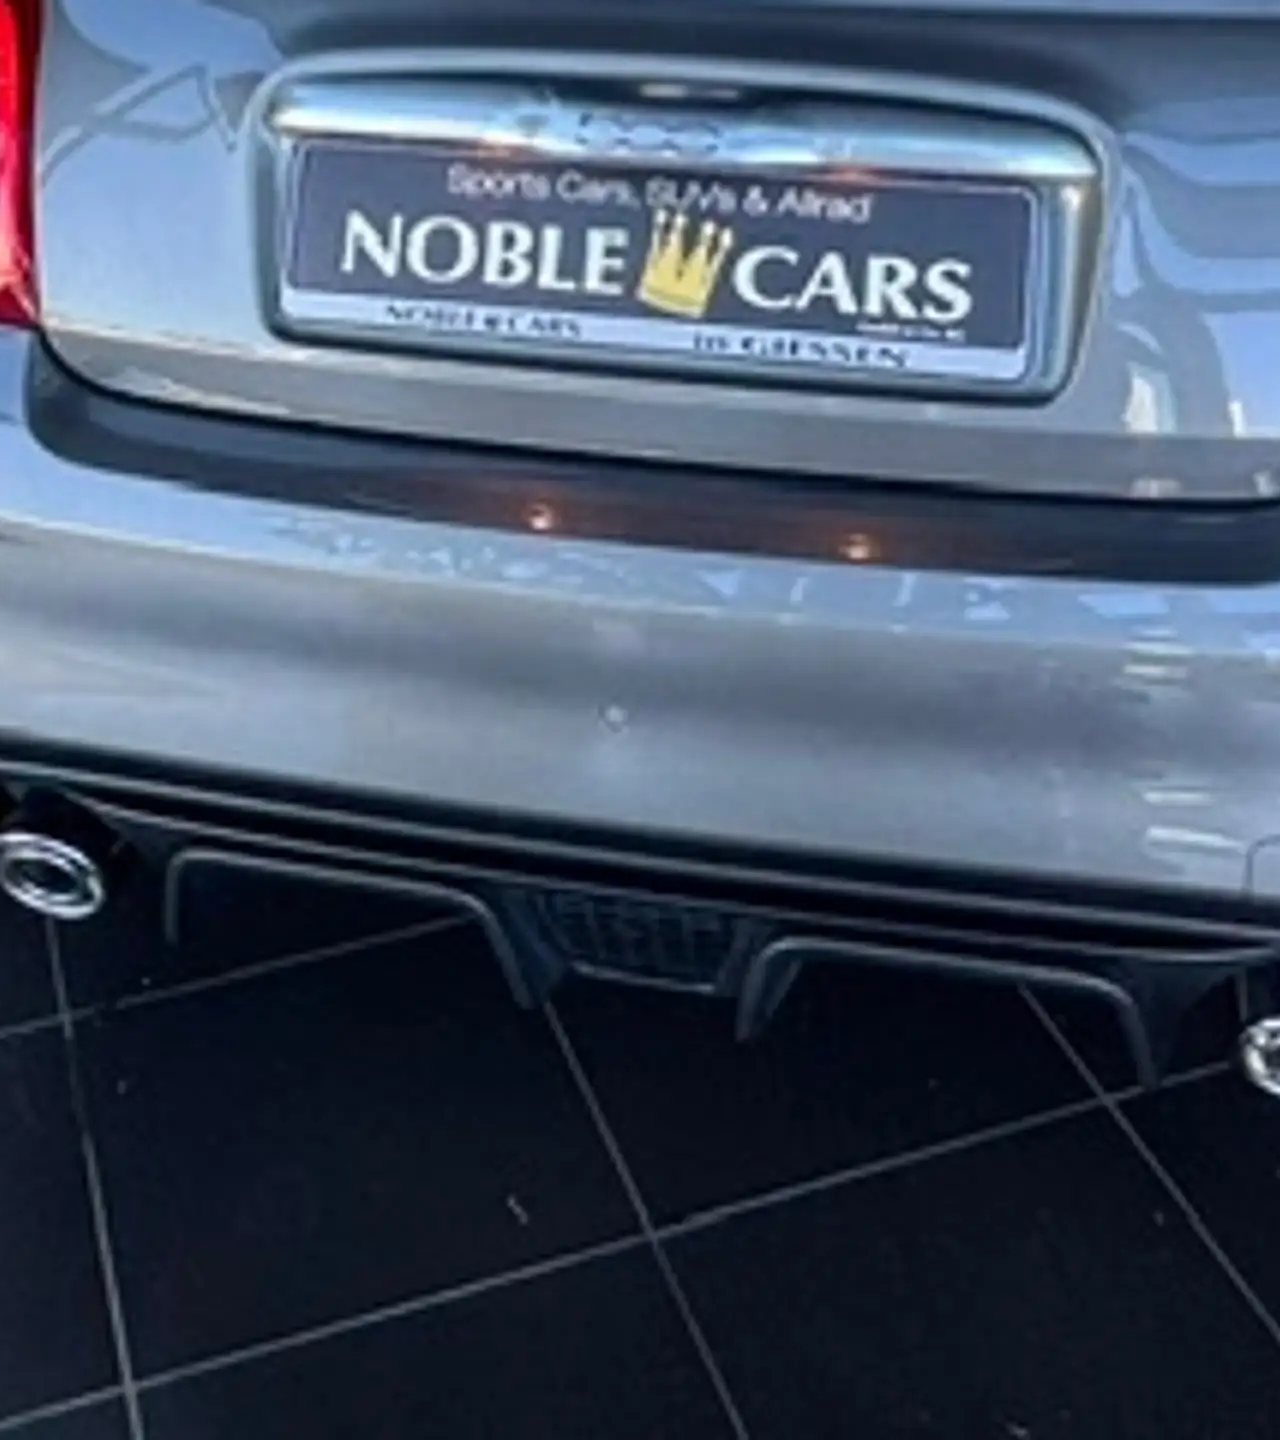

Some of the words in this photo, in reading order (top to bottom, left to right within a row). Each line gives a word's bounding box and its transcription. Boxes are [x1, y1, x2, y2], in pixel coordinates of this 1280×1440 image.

[447, 162, 551, 201] Sports
[645, 175, 737, 215] SUVs
[742, 185, 769, 217] &
[776, 186, 875, 225] Allrad
[339, 209, 631, 296] NOBLE
[732, 244, 973, 324] CARS
